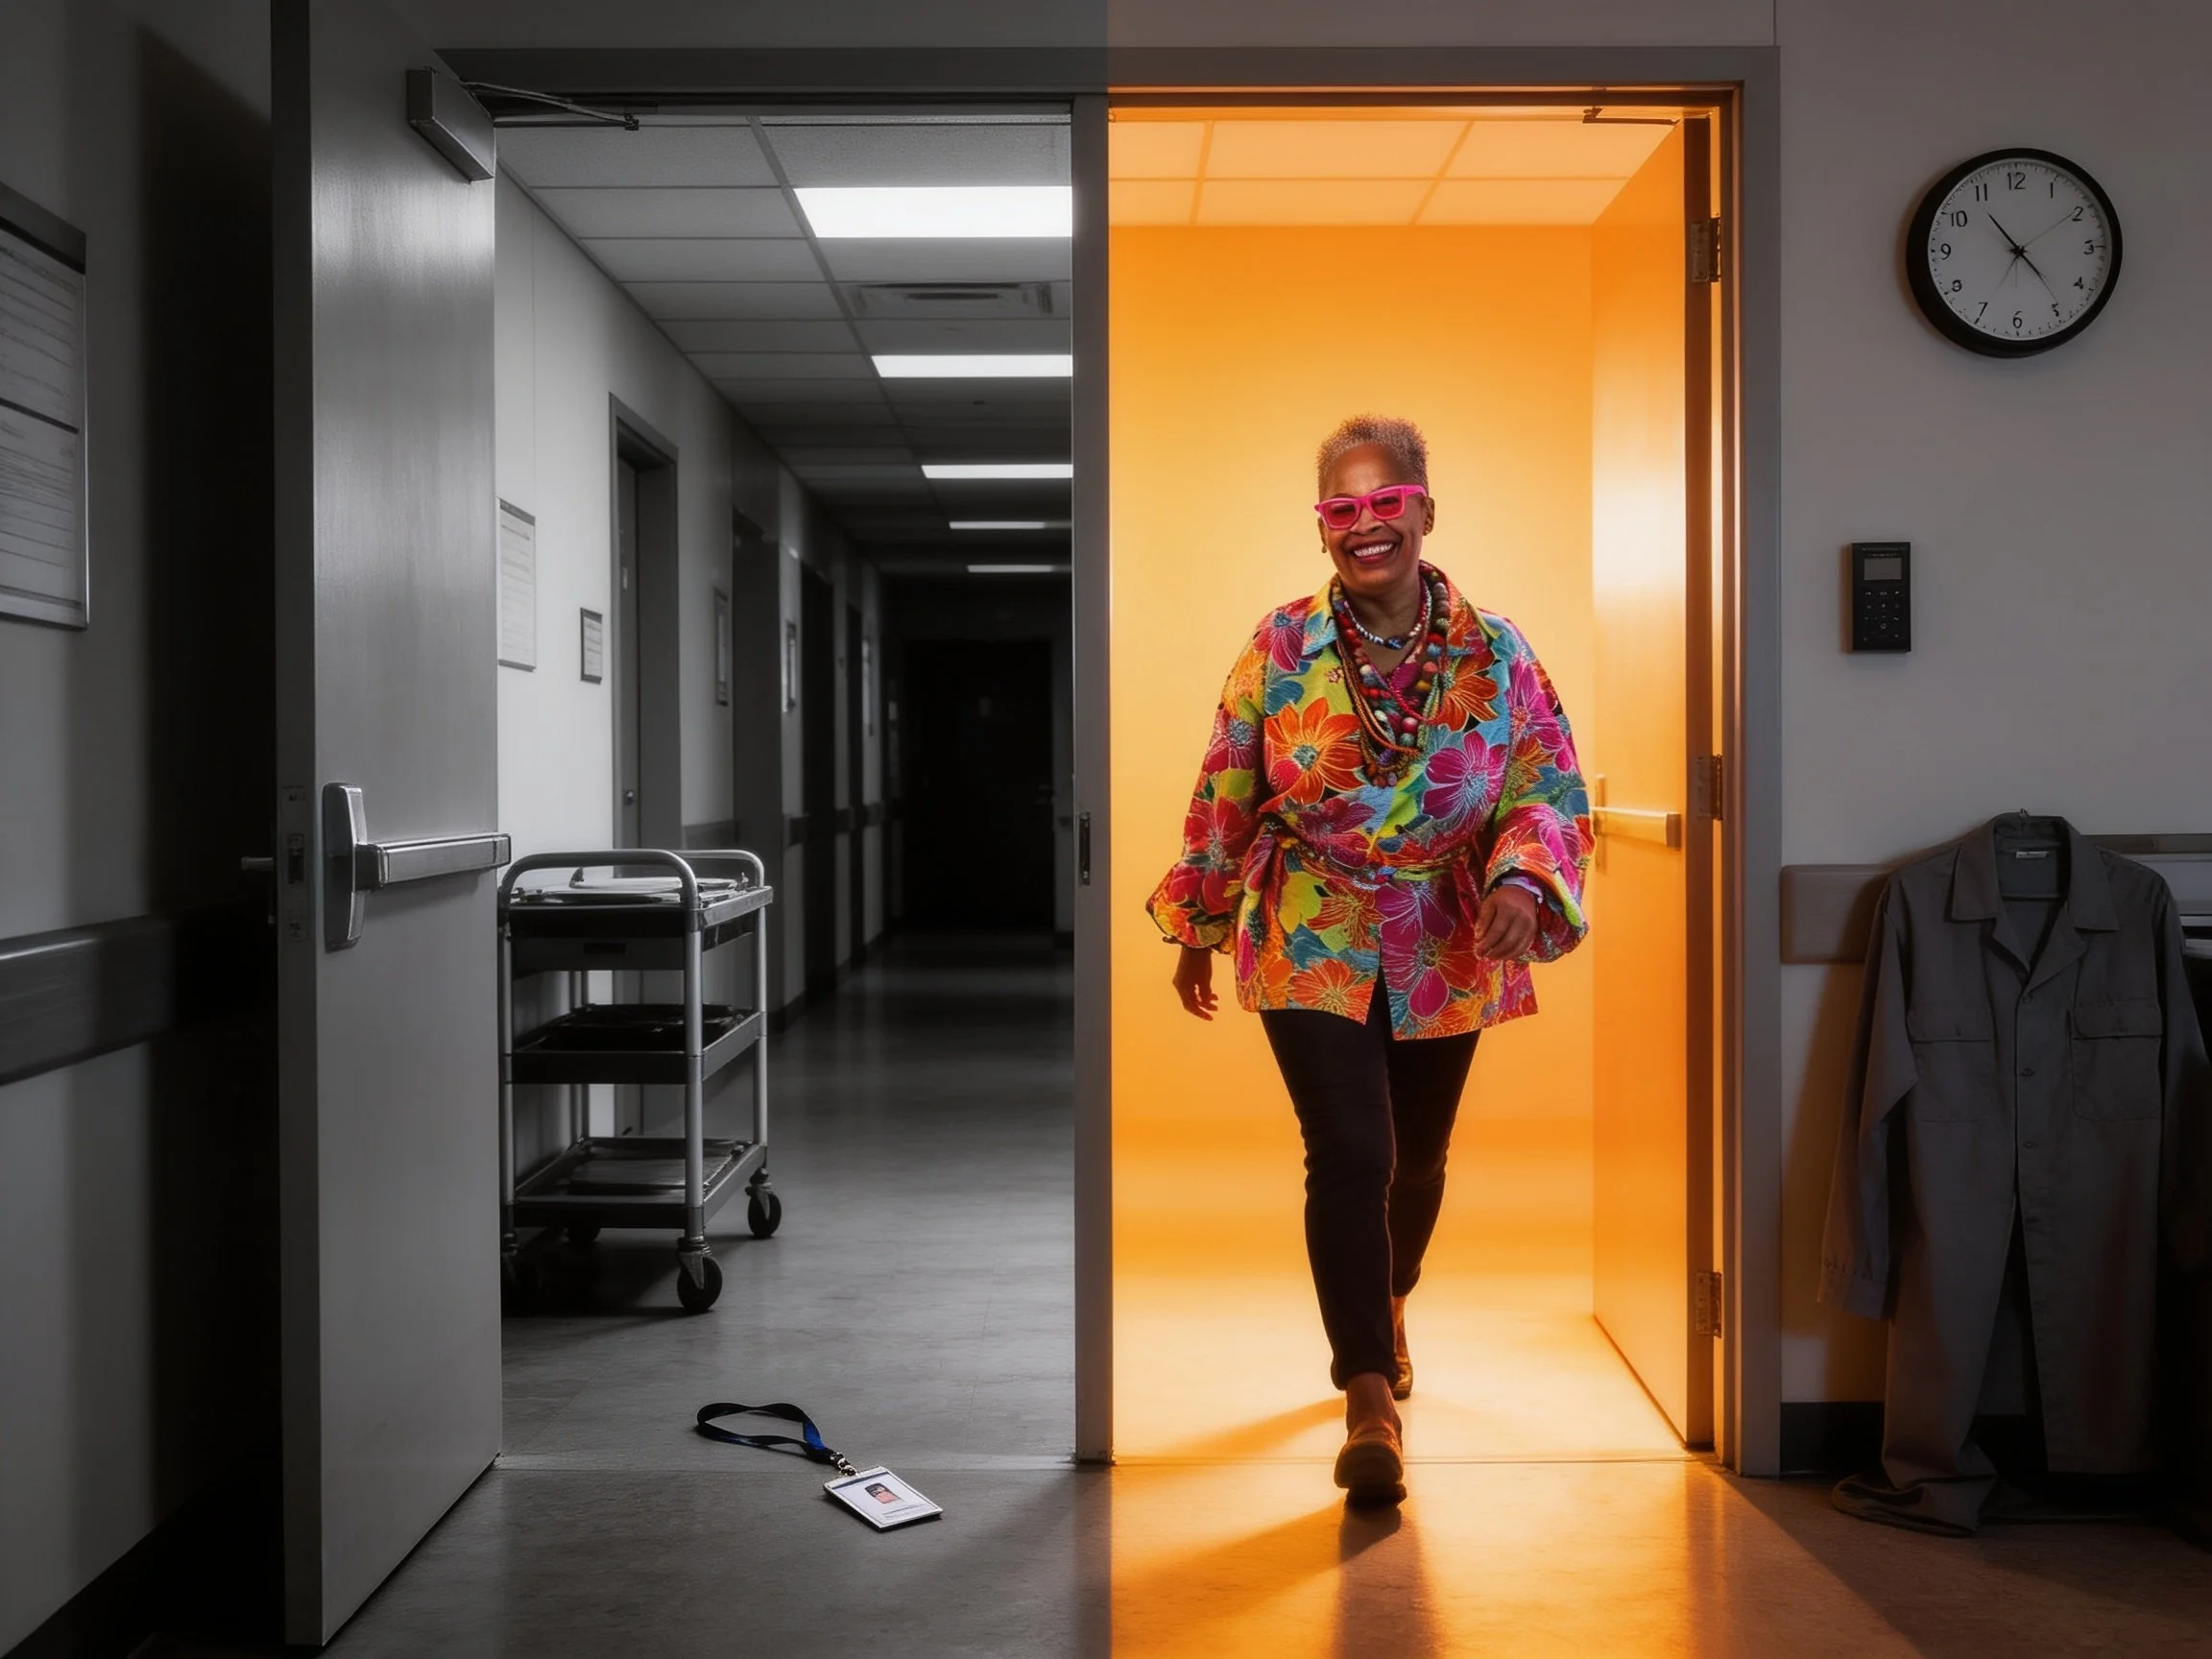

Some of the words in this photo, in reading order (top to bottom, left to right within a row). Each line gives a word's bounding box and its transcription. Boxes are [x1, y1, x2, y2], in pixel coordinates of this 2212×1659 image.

[2007, 172, 2026, 190] 12
[1975, 183, 1987, 202] 11
[1951, 210, 1967, 227] 10
[2072, 206, 2083, 222] 2
[1940, 243, 1952, 260] 9
[2083, 240, 2095, 255] 3
[1975, 301, 1988, 322] 7
[2012, 311, 2023, 329] 6
